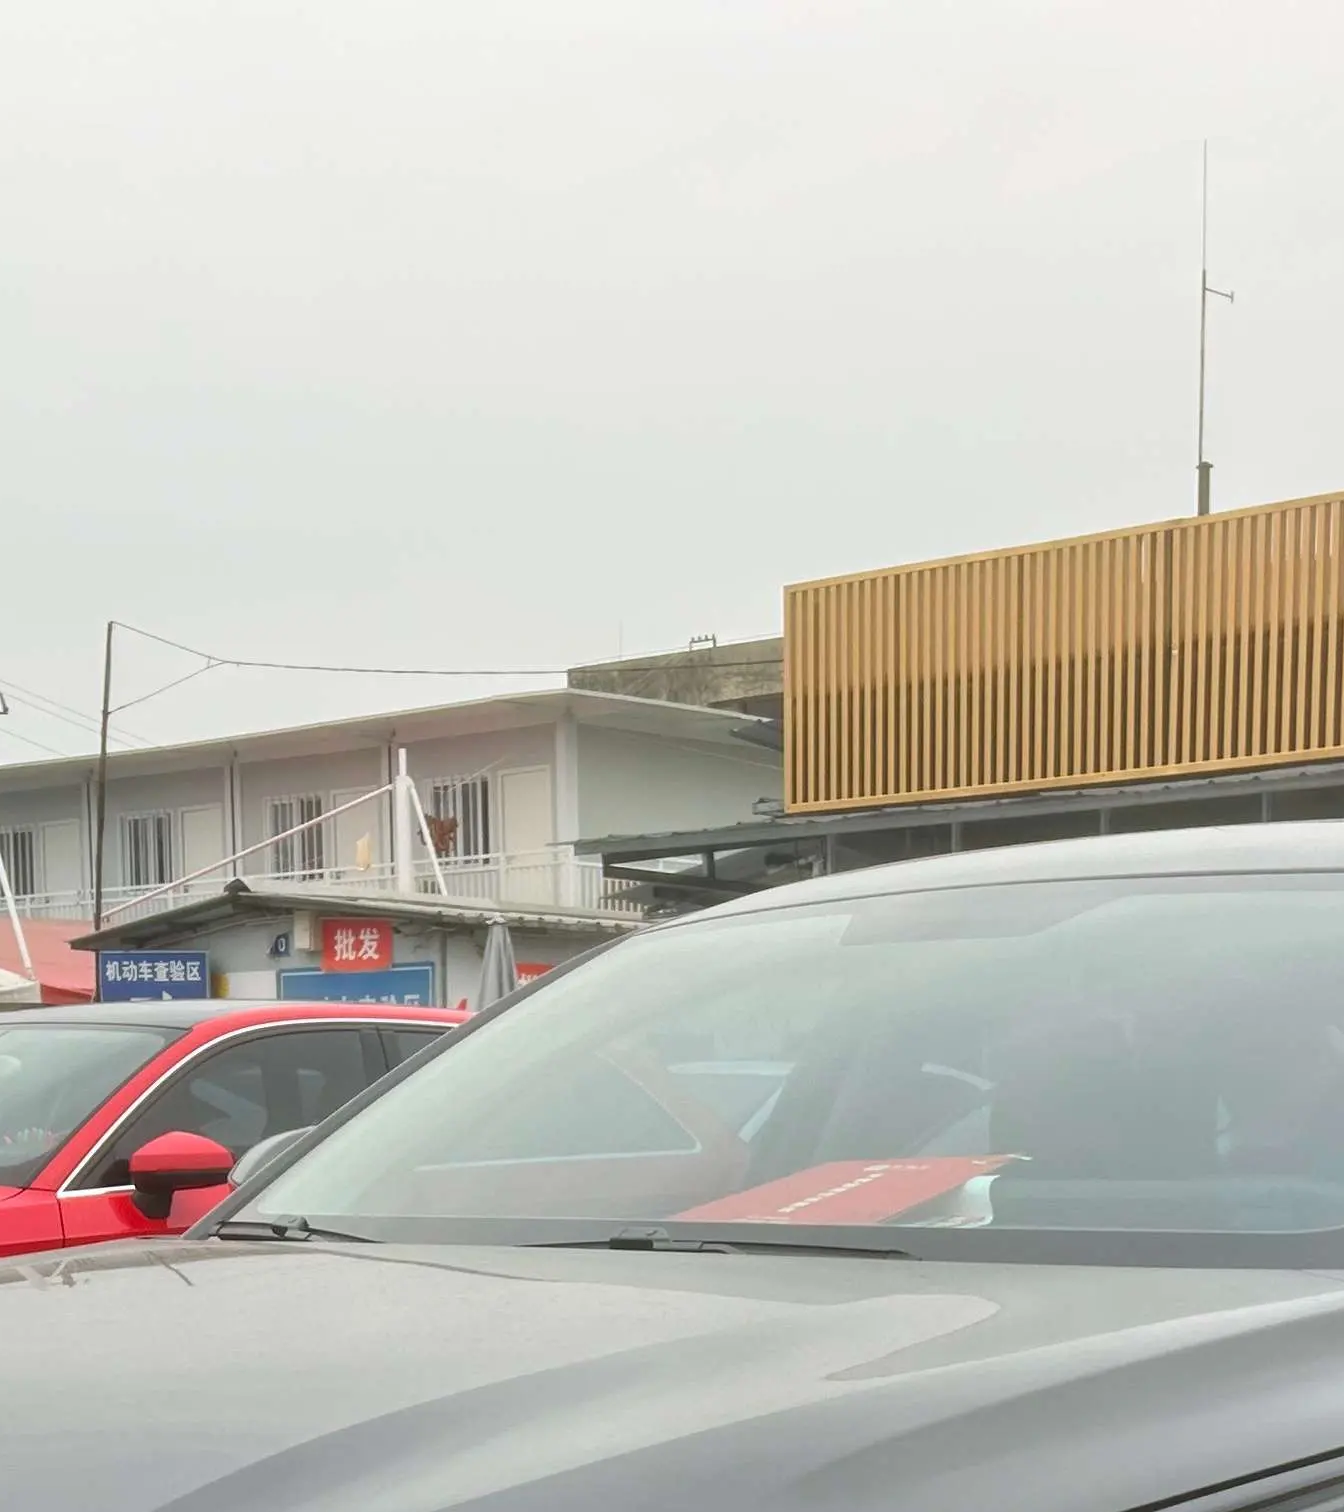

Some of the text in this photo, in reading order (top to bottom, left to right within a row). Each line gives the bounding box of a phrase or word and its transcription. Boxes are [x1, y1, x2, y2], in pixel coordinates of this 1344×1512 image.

[333, 927, 381, 961] 批发
[105, 960, 202, 982] 机动车查验区
